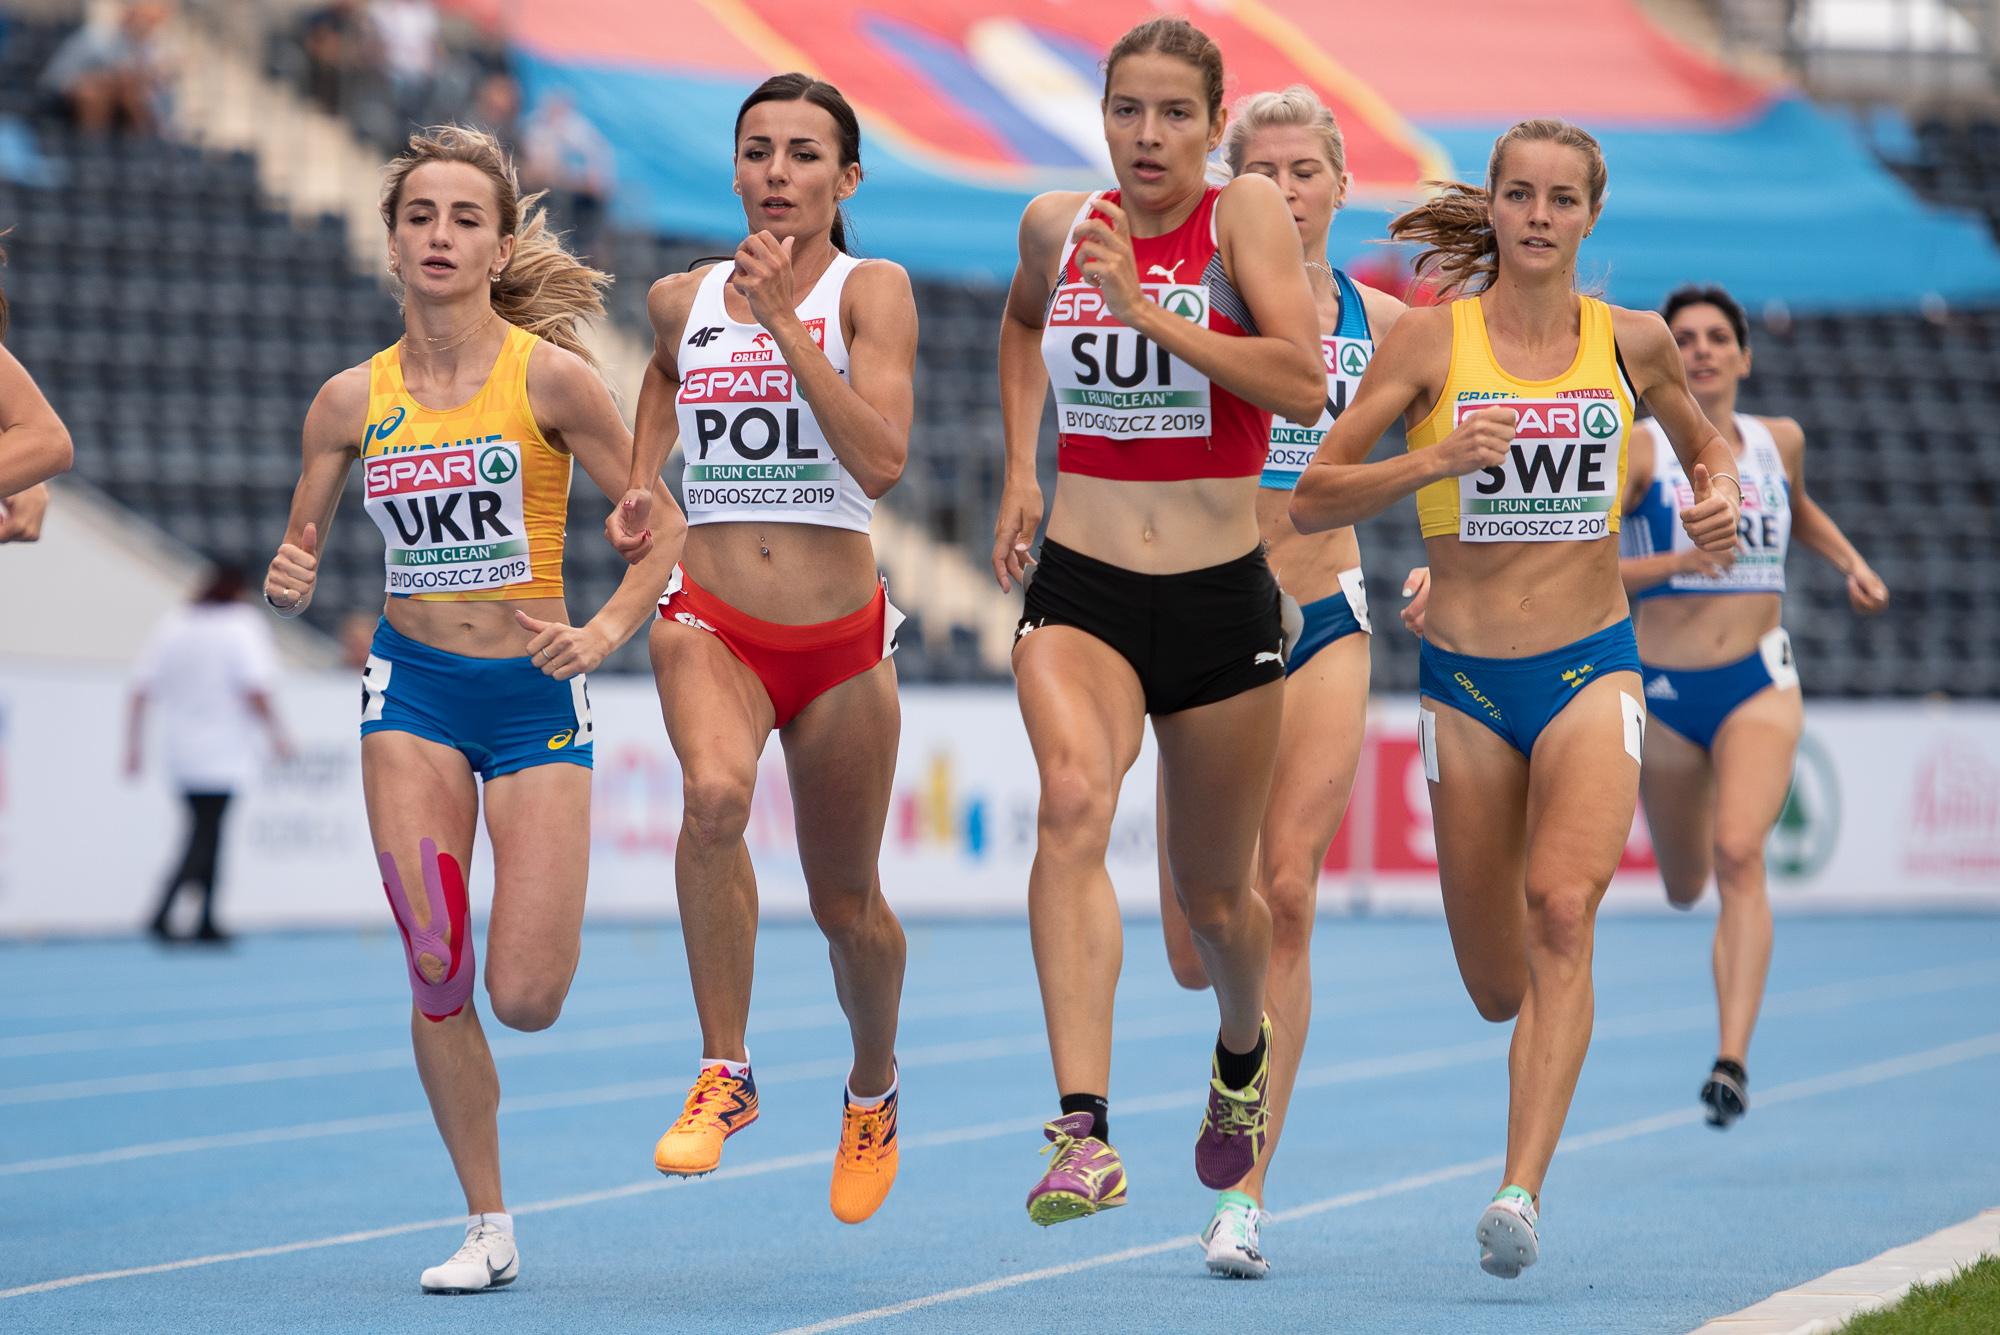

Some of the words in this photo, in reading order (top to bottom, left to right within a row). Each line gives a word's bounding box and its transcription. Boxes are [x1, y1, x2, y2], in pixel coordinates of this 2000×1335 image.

[733, 352, 771, 362] ORLEN
[1071, 332, 1171, 388] SUI
[683, 370, 789, 399] SPAR
[1557, 389, 1614, 399] BAUHAUS
[1089, 391, 1112, 404] RUN
[1066, 411, 1156, 433] BYDGOSZCZ
[1161, 414, 1206, 431] 2019
[695, 407, 819, 461] POL
[1270, 428, 1290, 442] UN
[369, 455, 473, 492] SPAR
[712, 467, 742, 479] RUN
[1476, 444, 1607, 494] SWE
[688, 488, 787, 505] BYDGOSZCZ
[793, 487, 835, 504] 2019
[1498, 500, 1530, 512] RUN
[383, 490, 513, 546] UKR
[1467, 520, 1573, 536] BYDGOSZCZ
[1736, 516, 1778, 548] RE
[409, 549, 438, 564] RUN
[390, 568, 485, 588] BYDGOSZCZ
[488, 561, 526, 582] 2019
[1453, 671, 1496, 711] CRAFT
